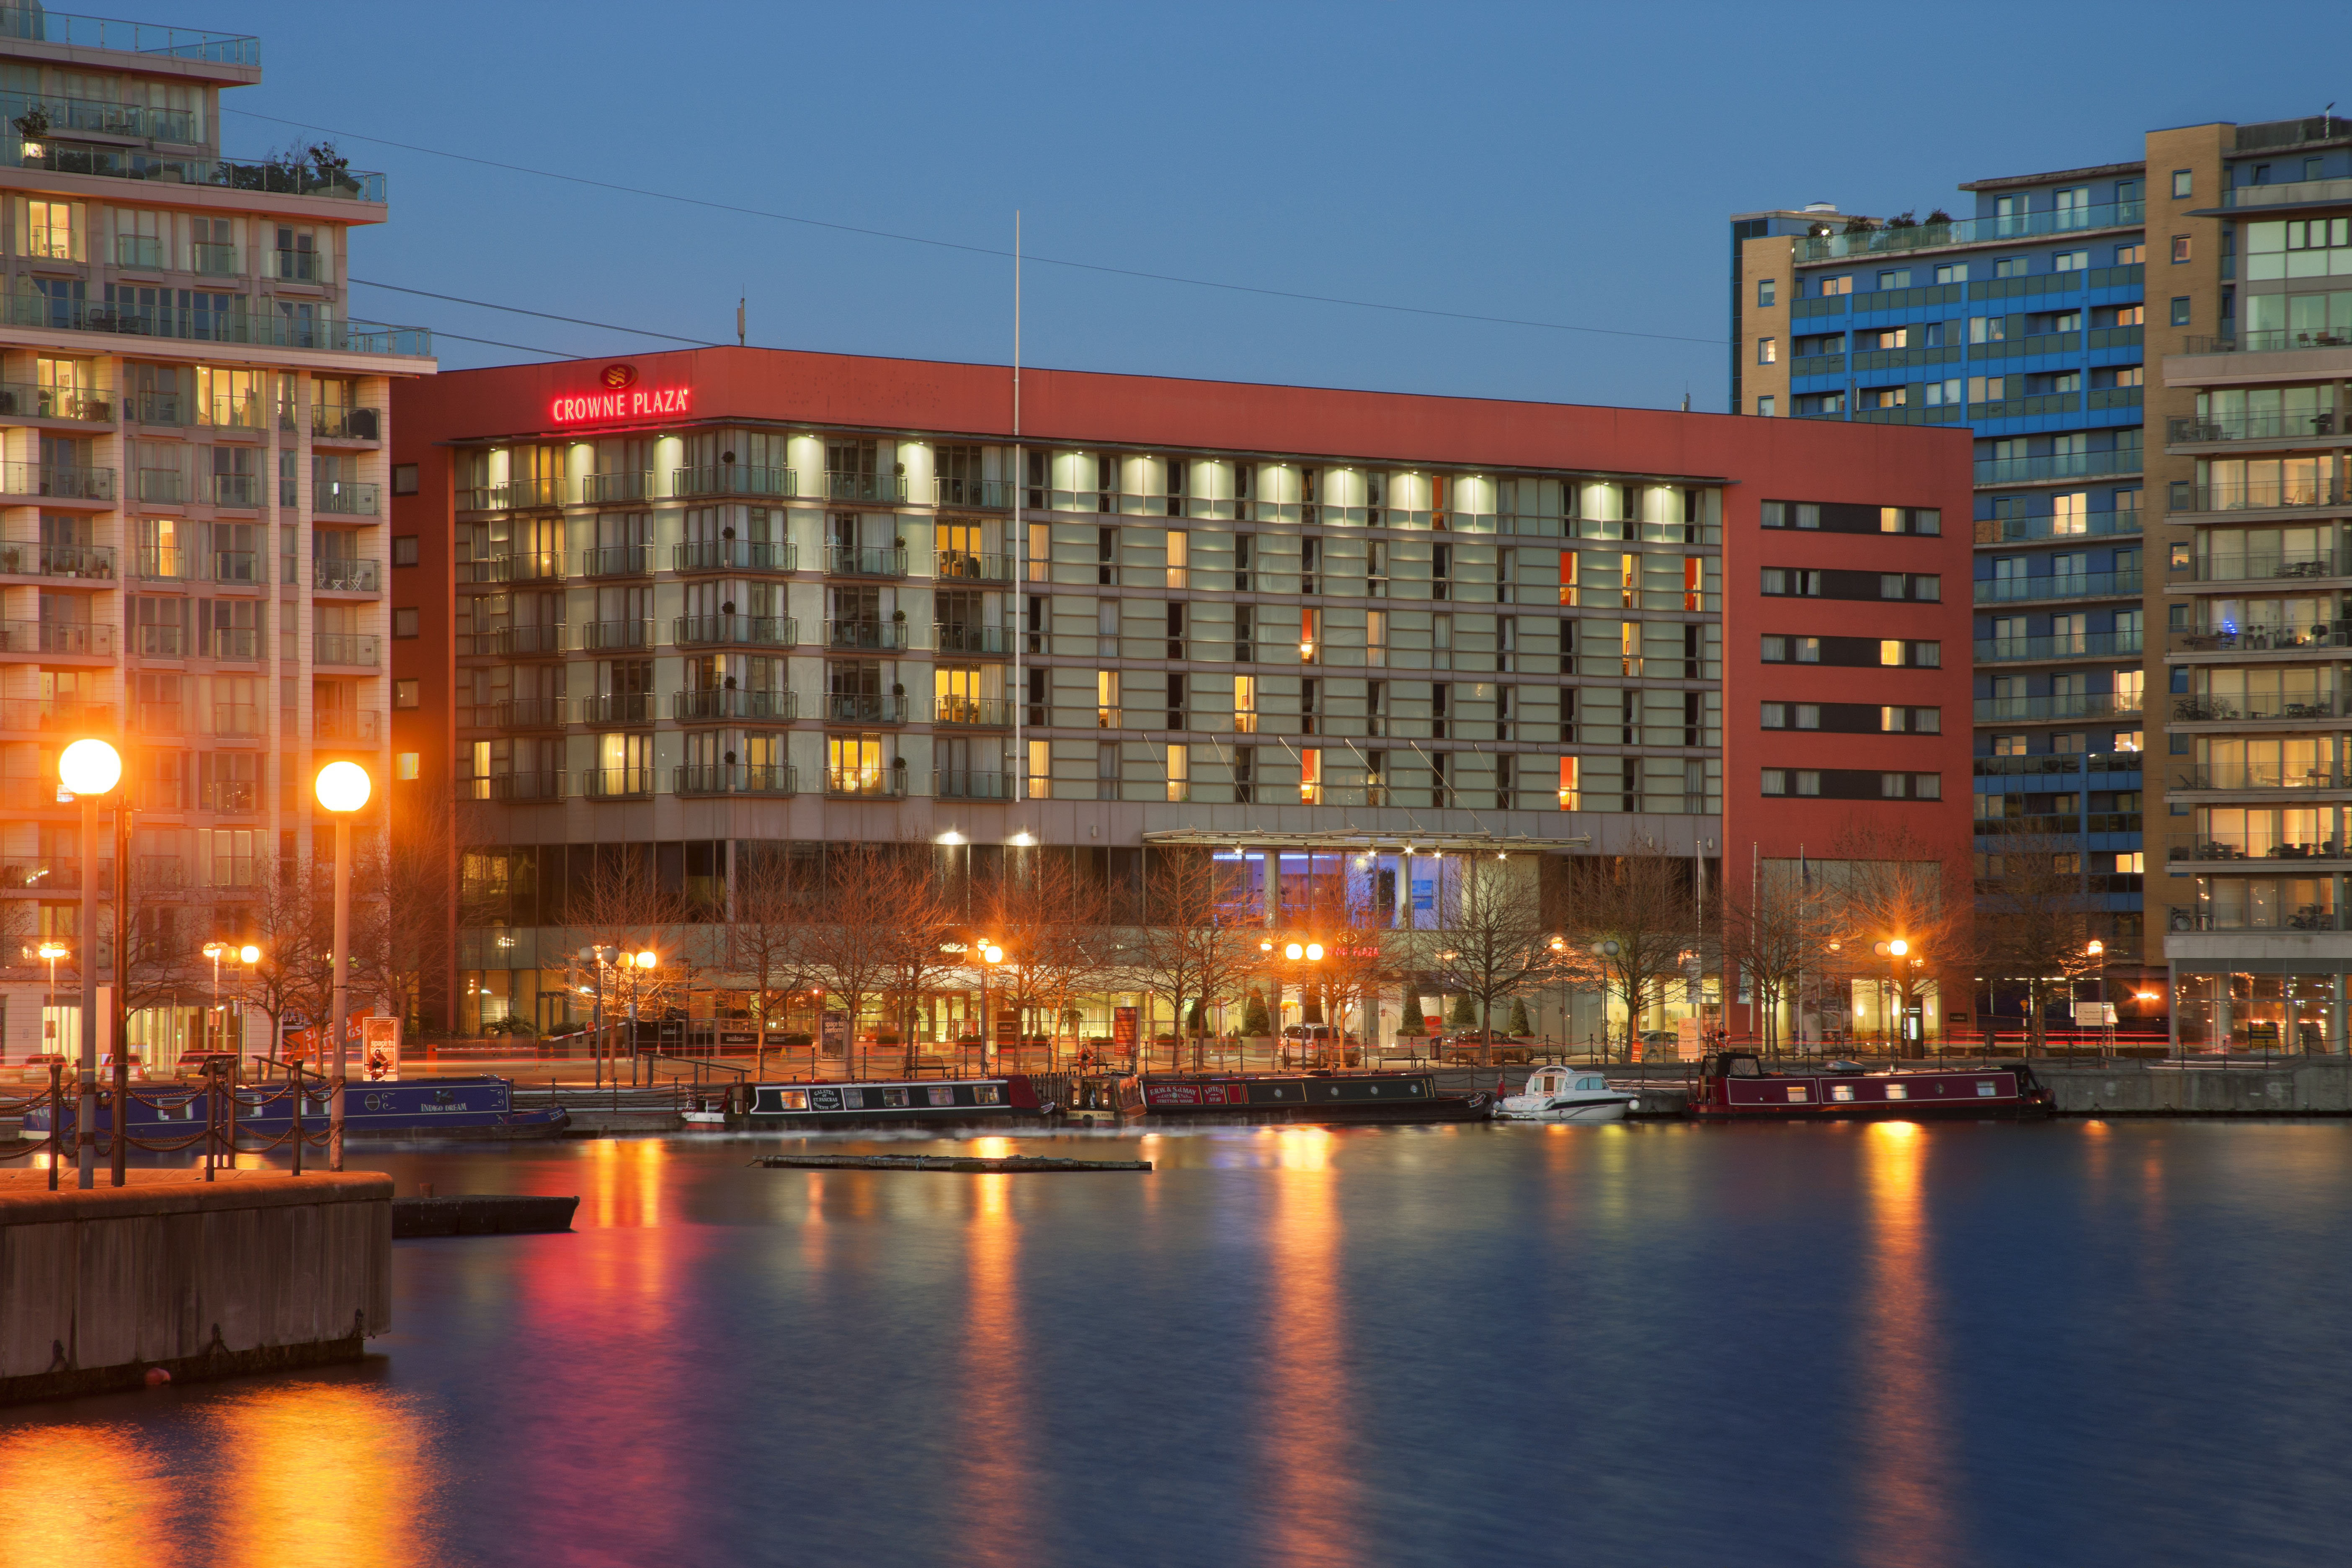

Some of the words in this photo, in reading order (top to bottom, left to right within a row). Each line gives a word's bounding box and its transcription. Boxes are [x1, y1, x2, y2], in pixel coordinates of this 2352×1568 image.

[553, 395, 625, 421] CROWNE
[634, 390, 686, 414] PLAZA
[1353, 947, 1378, 957] PLAZA
[421, 1103, 443, 1112] INDIGO
[445, 1102, 467, 1112] DREAM
